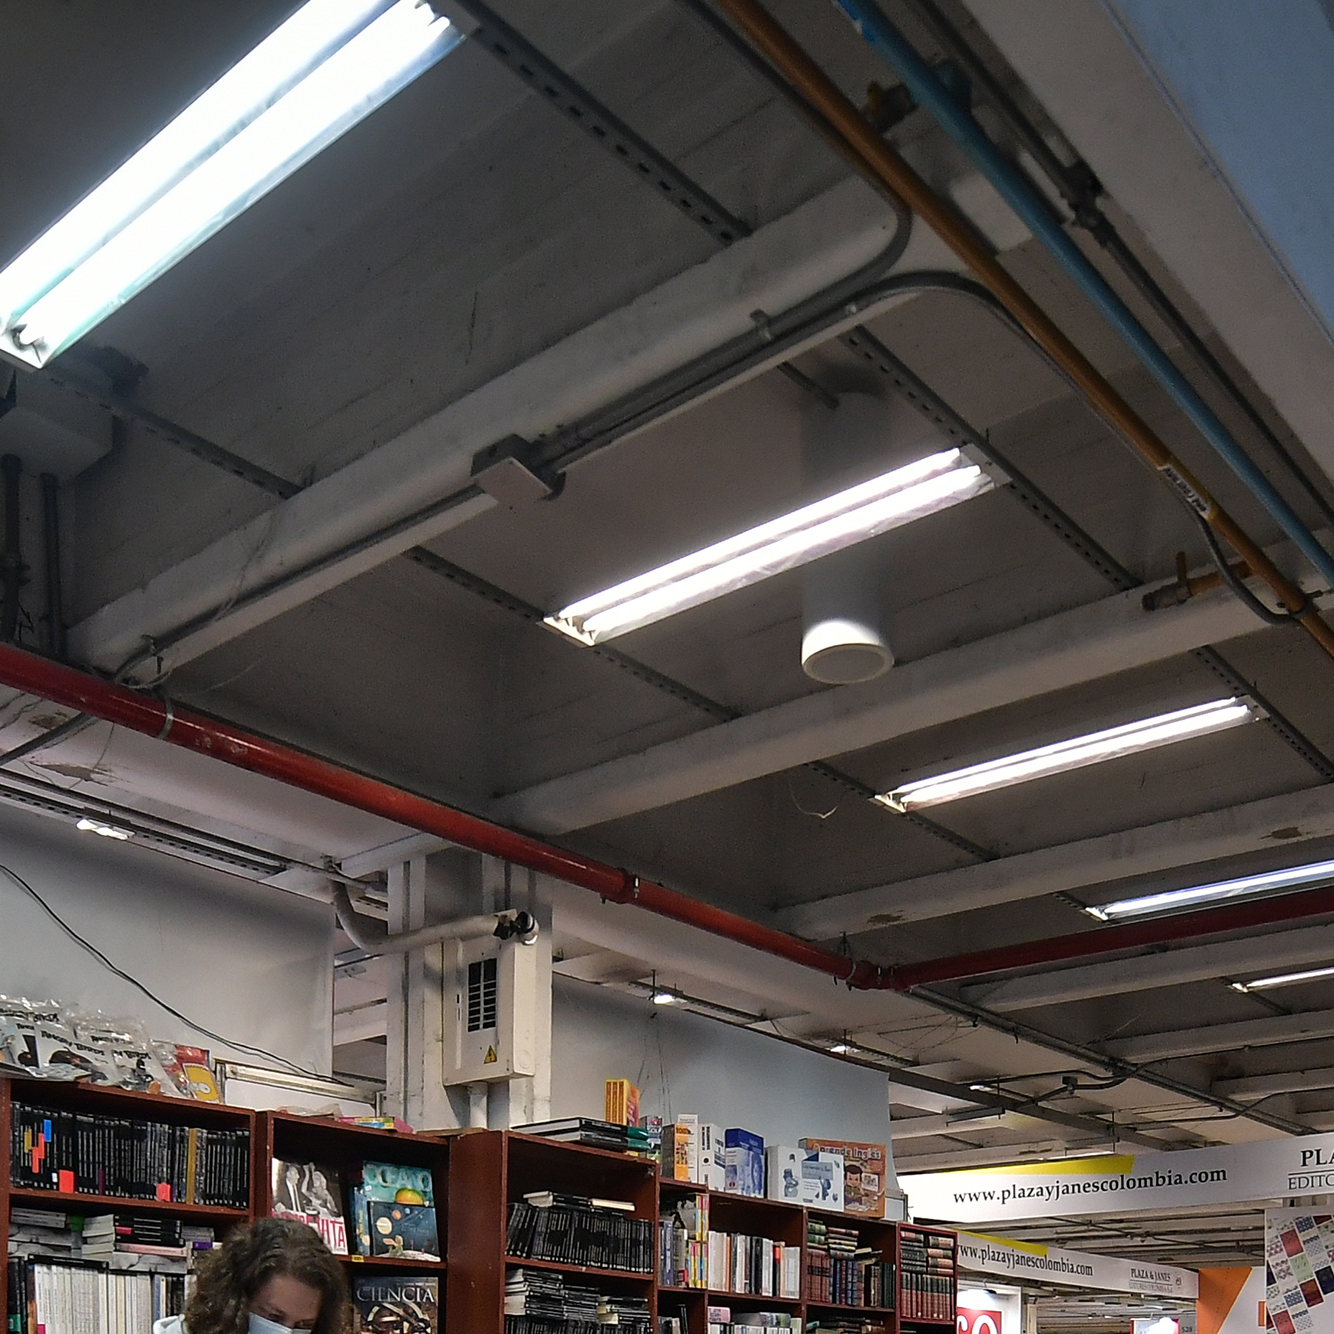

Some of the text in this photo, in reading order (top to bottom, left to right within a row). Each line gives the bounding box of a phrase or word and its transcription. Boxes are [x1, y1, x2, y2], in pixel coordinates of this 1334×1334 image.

[953, 1167, 1228, 1205] www.plazayjanescolombia.com
[1130, 1267, 1149, 1280] PLAZA
[356, 1286, 435, 1303] CIENCIA
